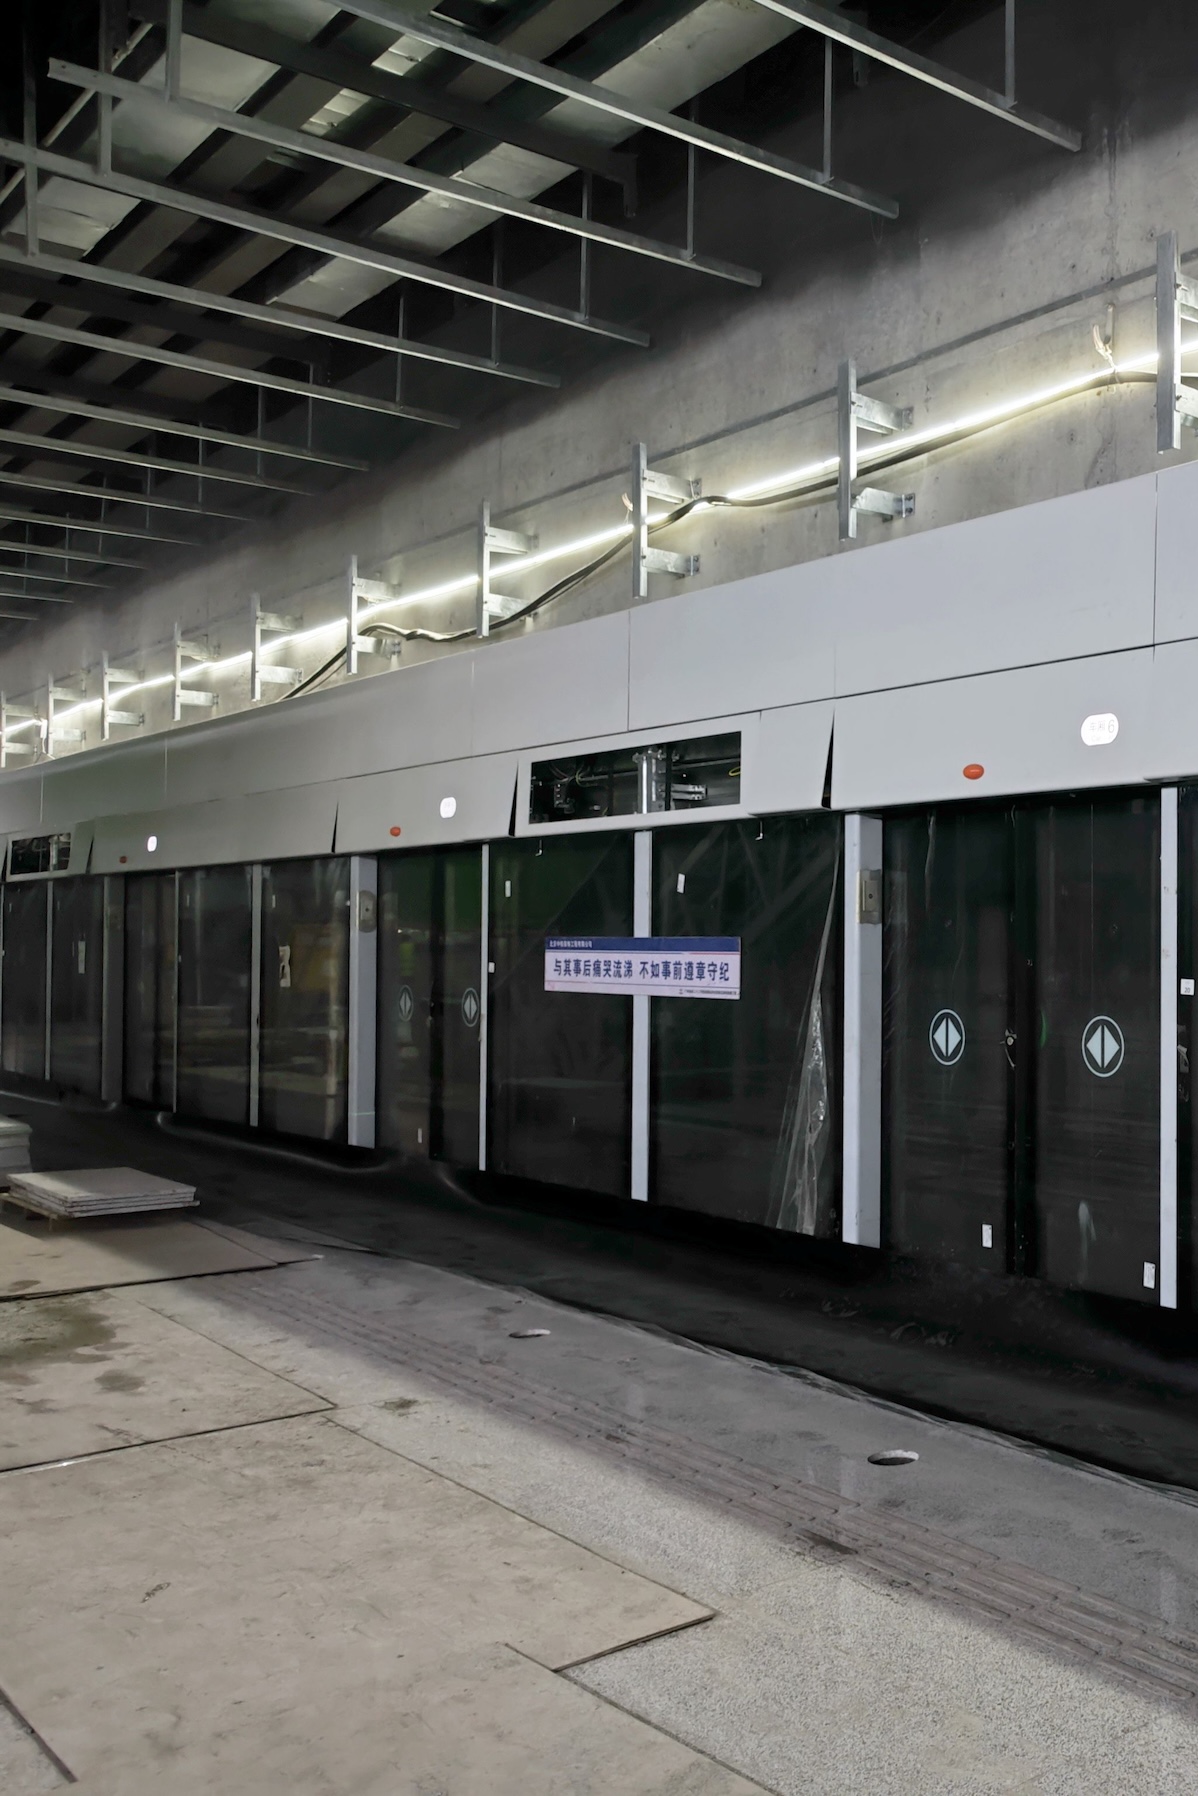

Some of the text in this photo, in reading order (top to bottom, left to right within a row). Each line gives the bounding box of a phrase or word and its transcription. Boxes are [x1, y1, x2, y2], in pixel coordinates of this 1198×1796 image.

[1107, 719, 1115, 733] 6
[553, 958, 730, 981] 与其事后痛哭流涕 不如事前遵章守纪
